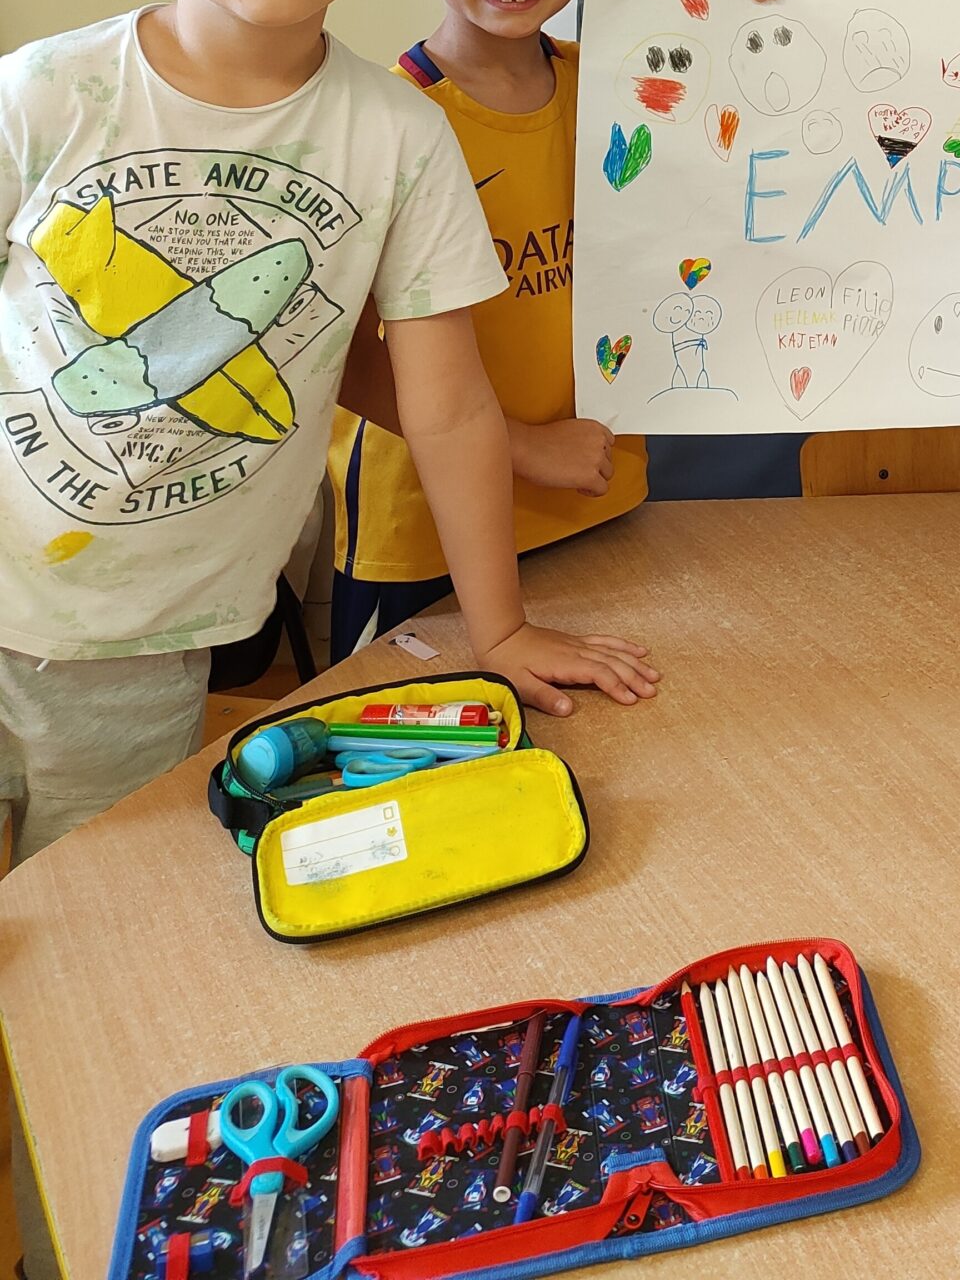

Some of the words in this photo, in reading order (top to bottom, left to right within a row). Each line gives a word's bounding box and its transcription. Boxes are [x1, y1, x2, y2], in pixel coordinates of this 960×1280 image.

[77, 162, 182, 206] SKATE
[204, 162, 270, 194] AND
[280, 179, 347, 235] SURF
[174, 209, 199, 226] NO
[206, 212, 240, 226] ONE
[148, 225, 164, 234] CAN
[168, 228, 190, 236] STOP
[168, 246, 203, 255] READING
[776, 286, 826, 304] LEON
[778, 332, 838, 350] KAJETAN
[145, 415, 167, 424] NEW
[6, 412, 49, 458] ON
[47, 460, 109, 510] THE
[119, 455, 250, 514] STREET
